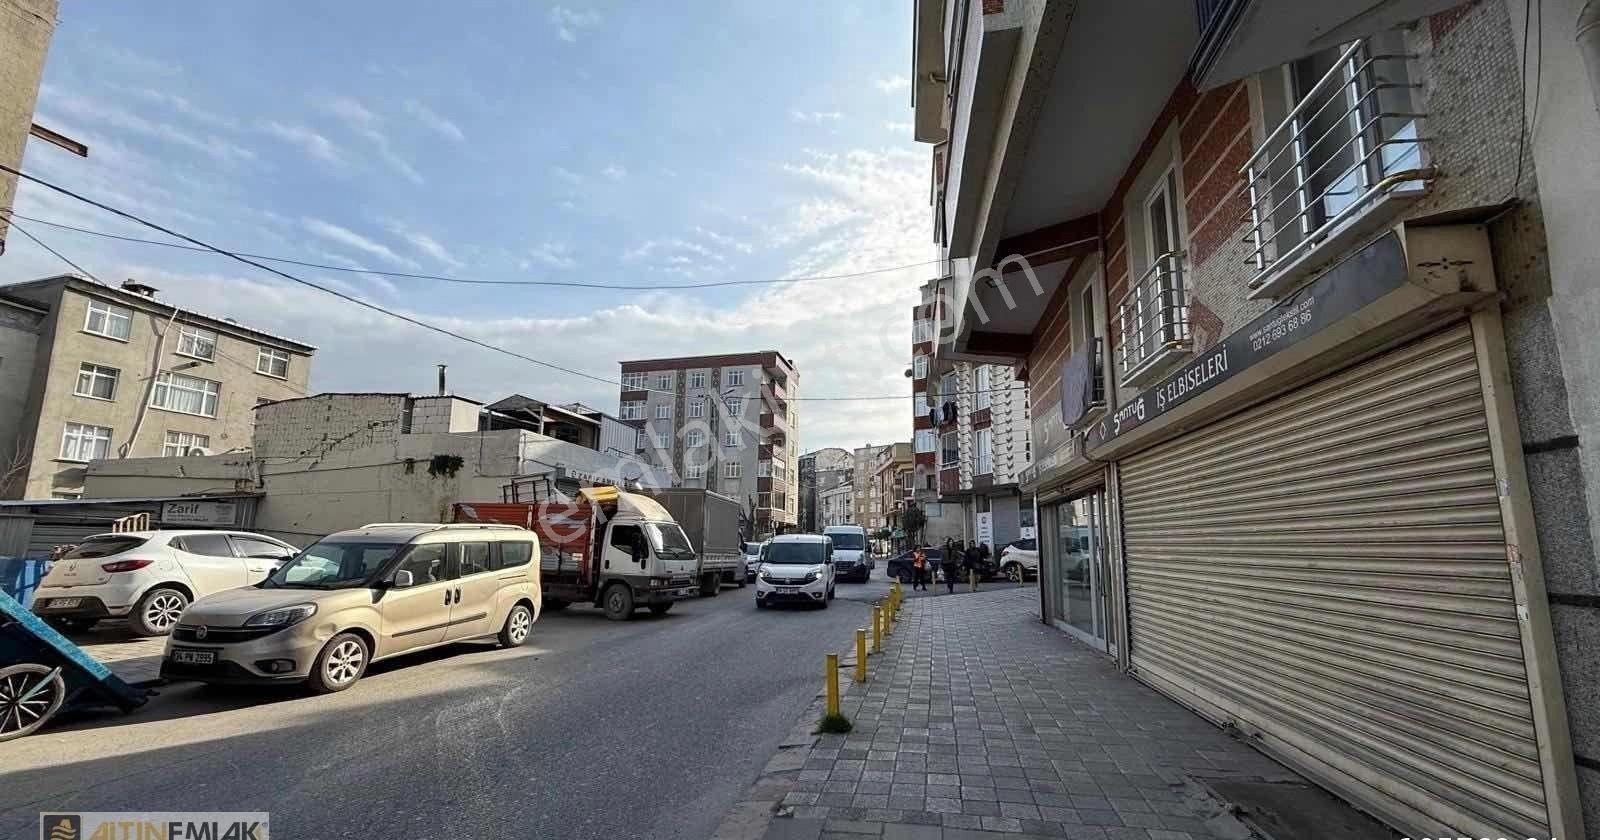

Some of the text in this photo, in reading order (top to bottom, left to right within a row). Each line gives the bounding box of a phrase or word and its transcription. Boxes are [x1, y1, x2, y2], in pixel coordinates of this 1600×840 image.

[1156, 387, 1166, 411] İŞ
[1167, 344, 1228, 402] ELBİSELERİ
[167, 503, 199, 514] Zarif
